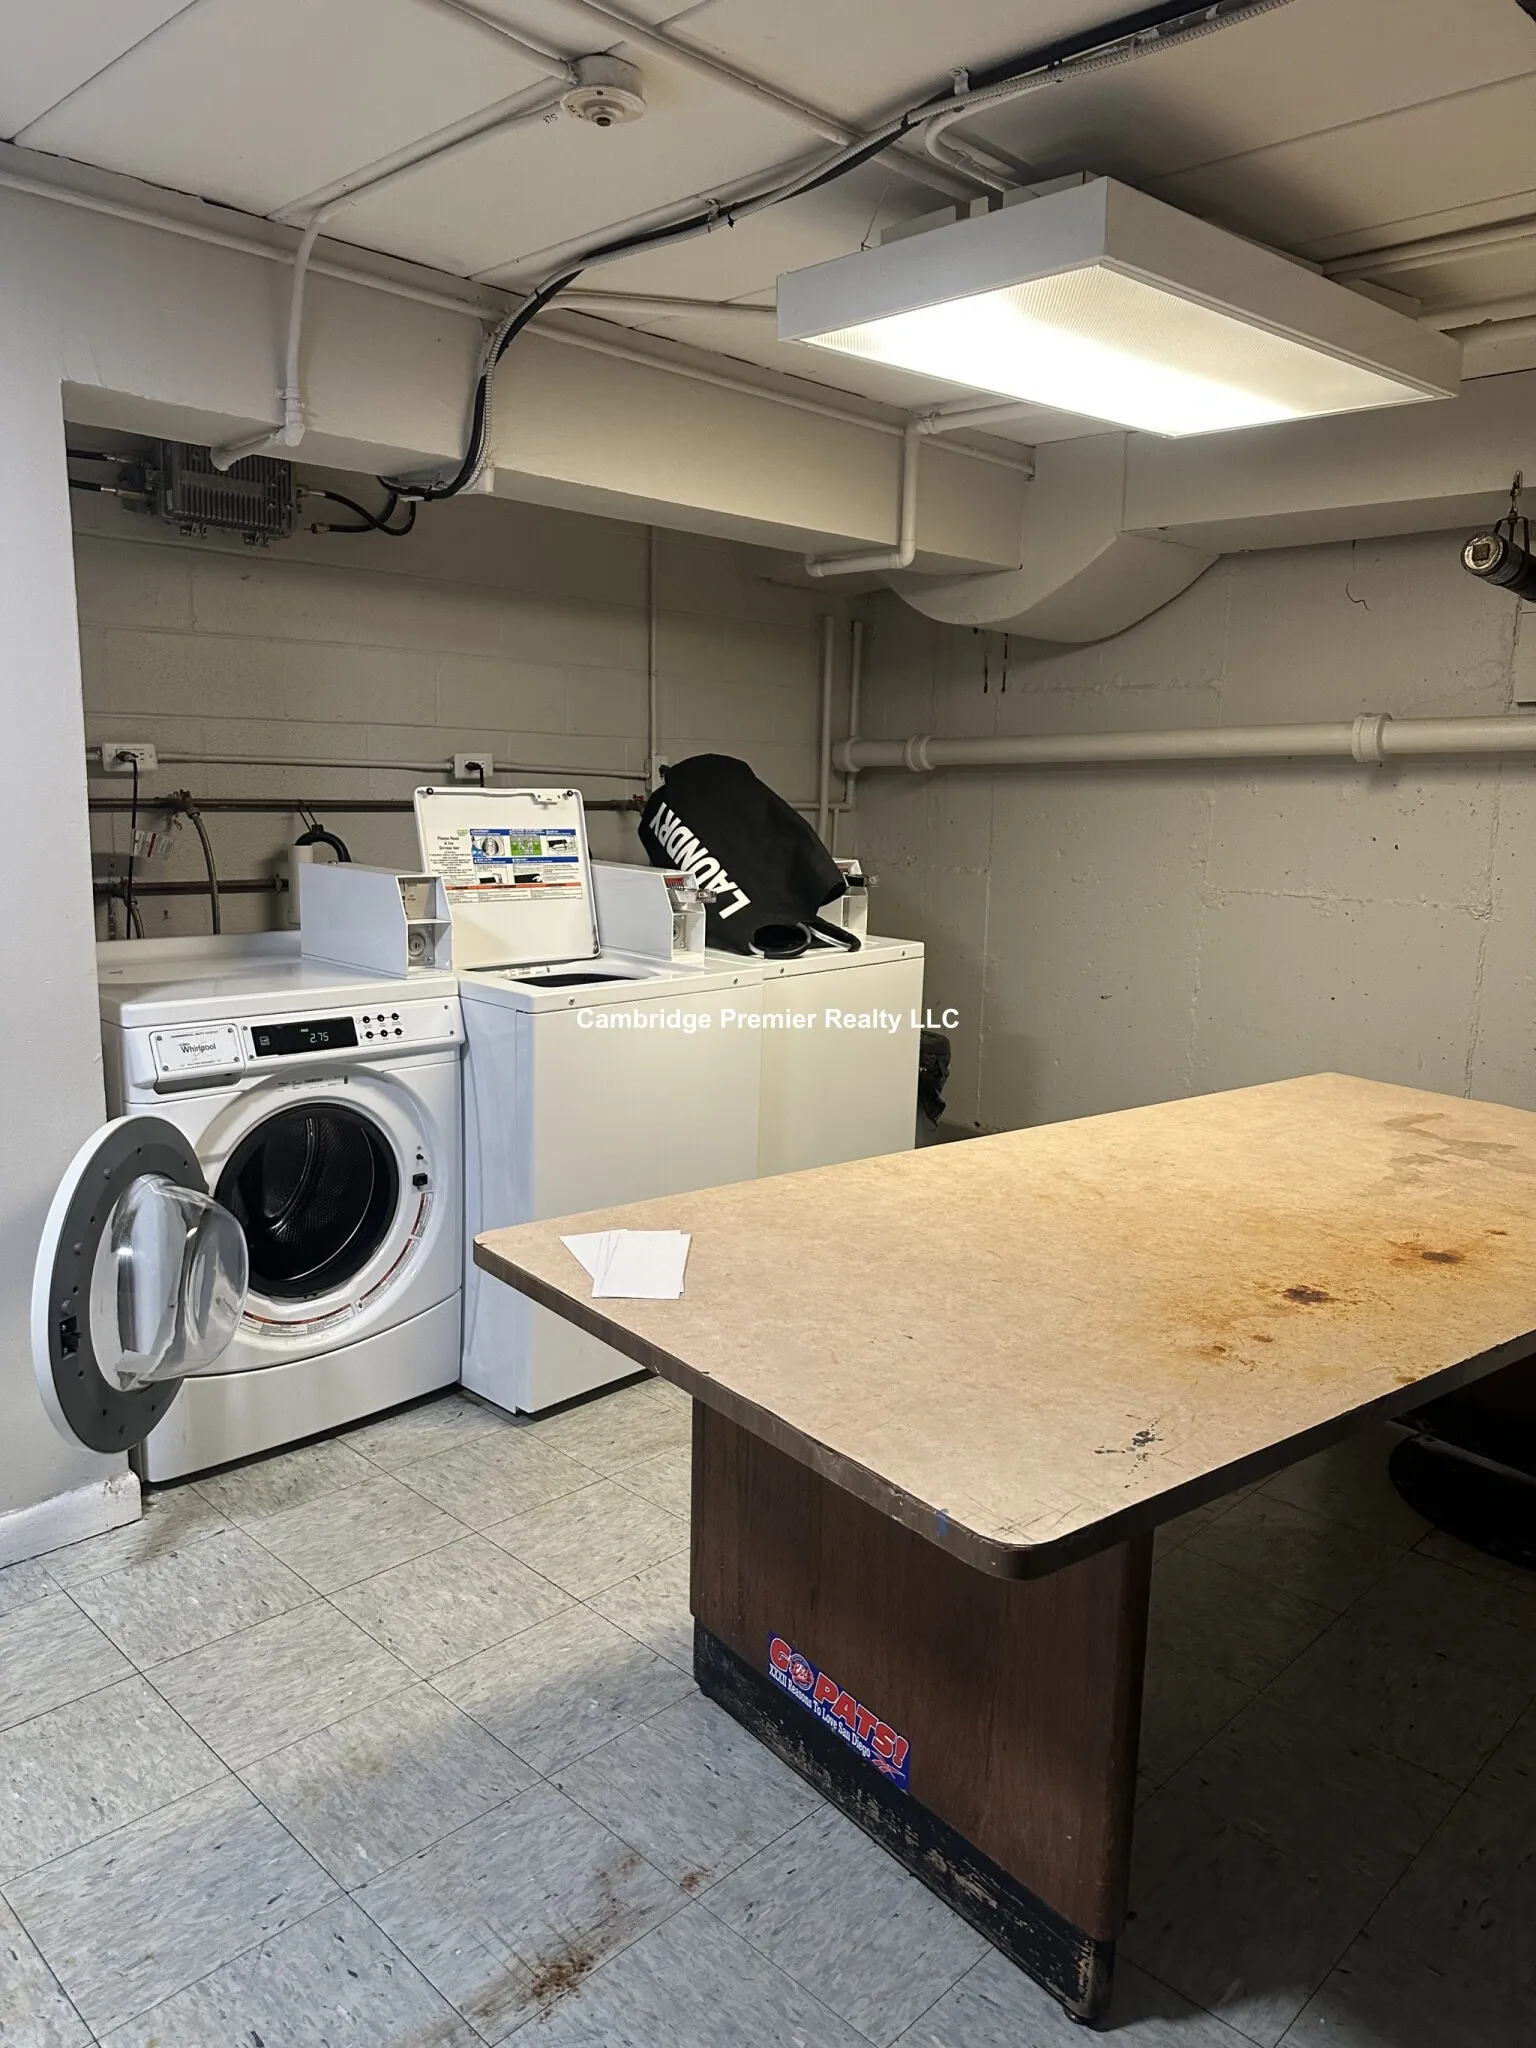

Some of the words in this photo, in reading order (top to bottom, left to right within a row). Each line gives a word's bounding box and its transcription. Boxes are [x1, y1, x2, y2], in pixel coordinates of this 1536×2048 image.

[649, 802, 751, 920] LAUNDRY
[180, 1042, 217, 1053] Whirlpool
[310, 1031, 329, 1044] 2.75
[787, 1678, 812, 1708] Reasons
[812, 1699, 822, 1716] To
[822, 1707, 838, 1730] Love
[838, 1721, 851, 1741] San
[851, 1732, 871, 1758] Diego
[813, 1671, 909, 1769] PATS!
